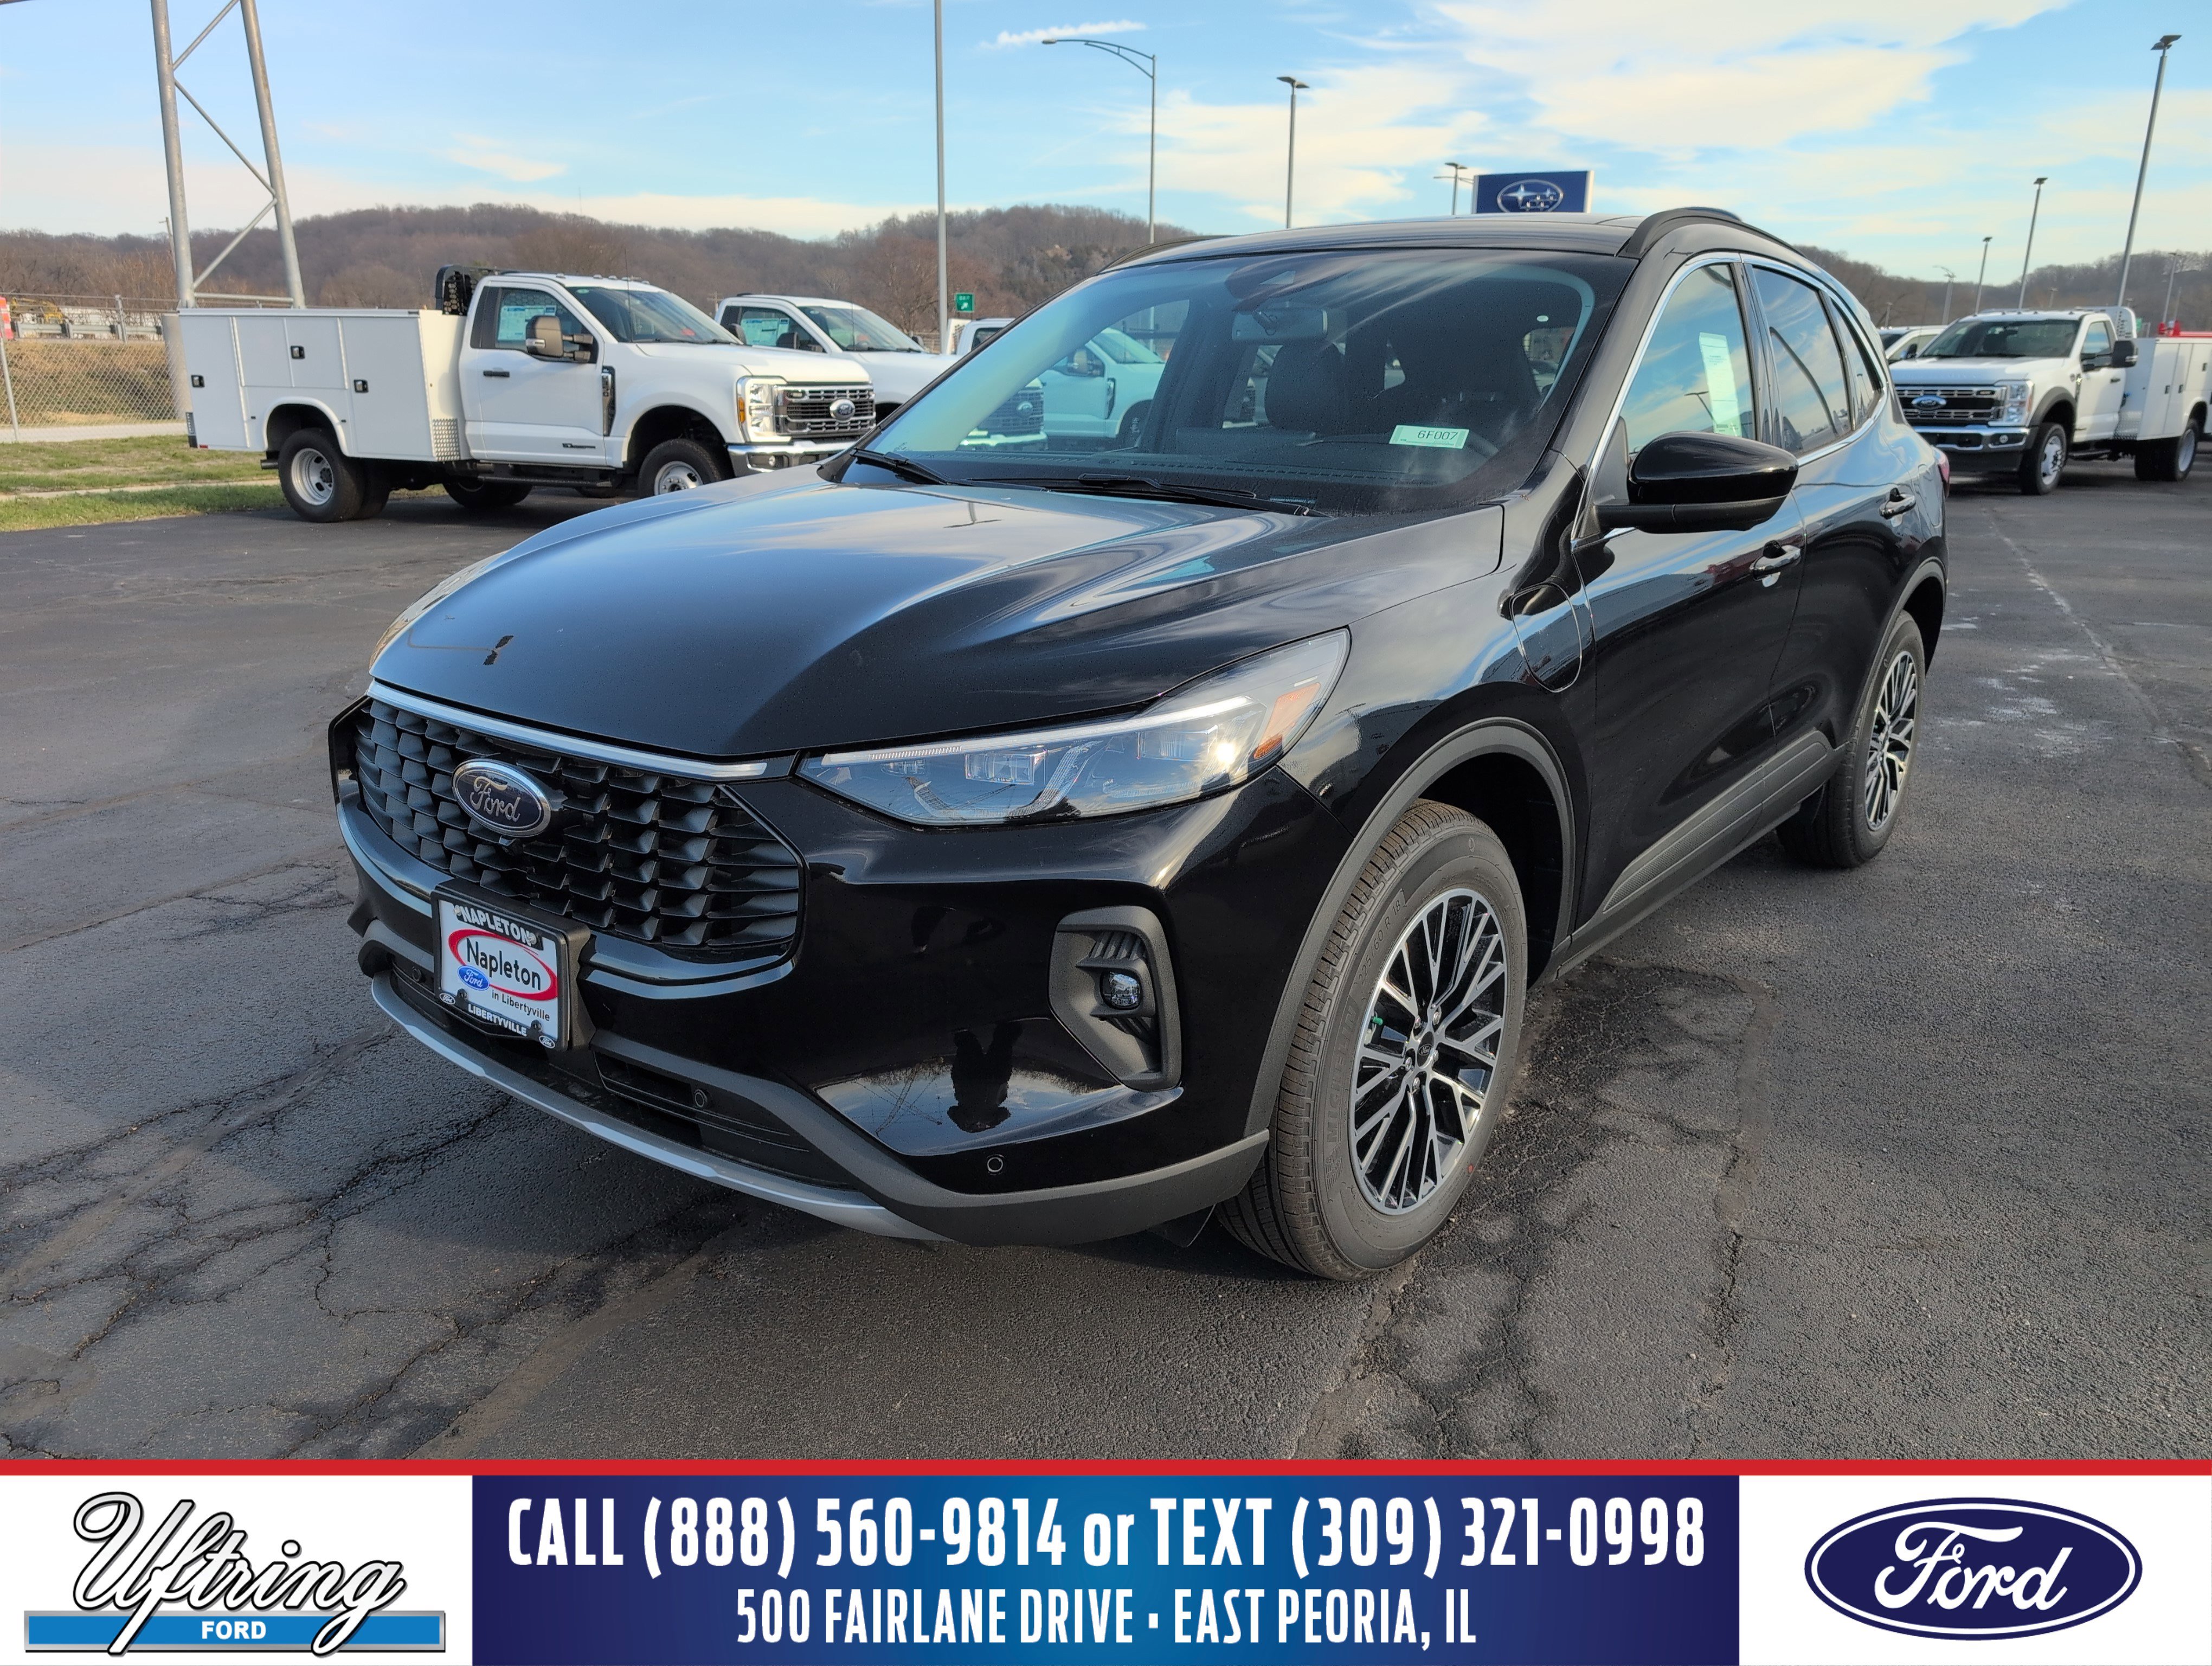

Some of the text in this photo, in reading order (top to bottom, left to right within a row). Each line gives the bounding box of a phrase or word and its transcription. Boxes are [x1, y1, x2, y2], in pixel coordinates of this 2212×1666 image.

[1417, 430, 1458, 440] 6F007
[470, 776, 521, 822] Ford
[460, 906, 532, 946] NAPLETON
[1358, 900, 1401, 985] 225/60 R 18
[464, 970, 483, 988] Ford
[466, 938, 541, 990] Napleton
[468, 1003, 528, 1037] LIBERTYVILLE
[491, 989, 550, 1022] in Libertyville
